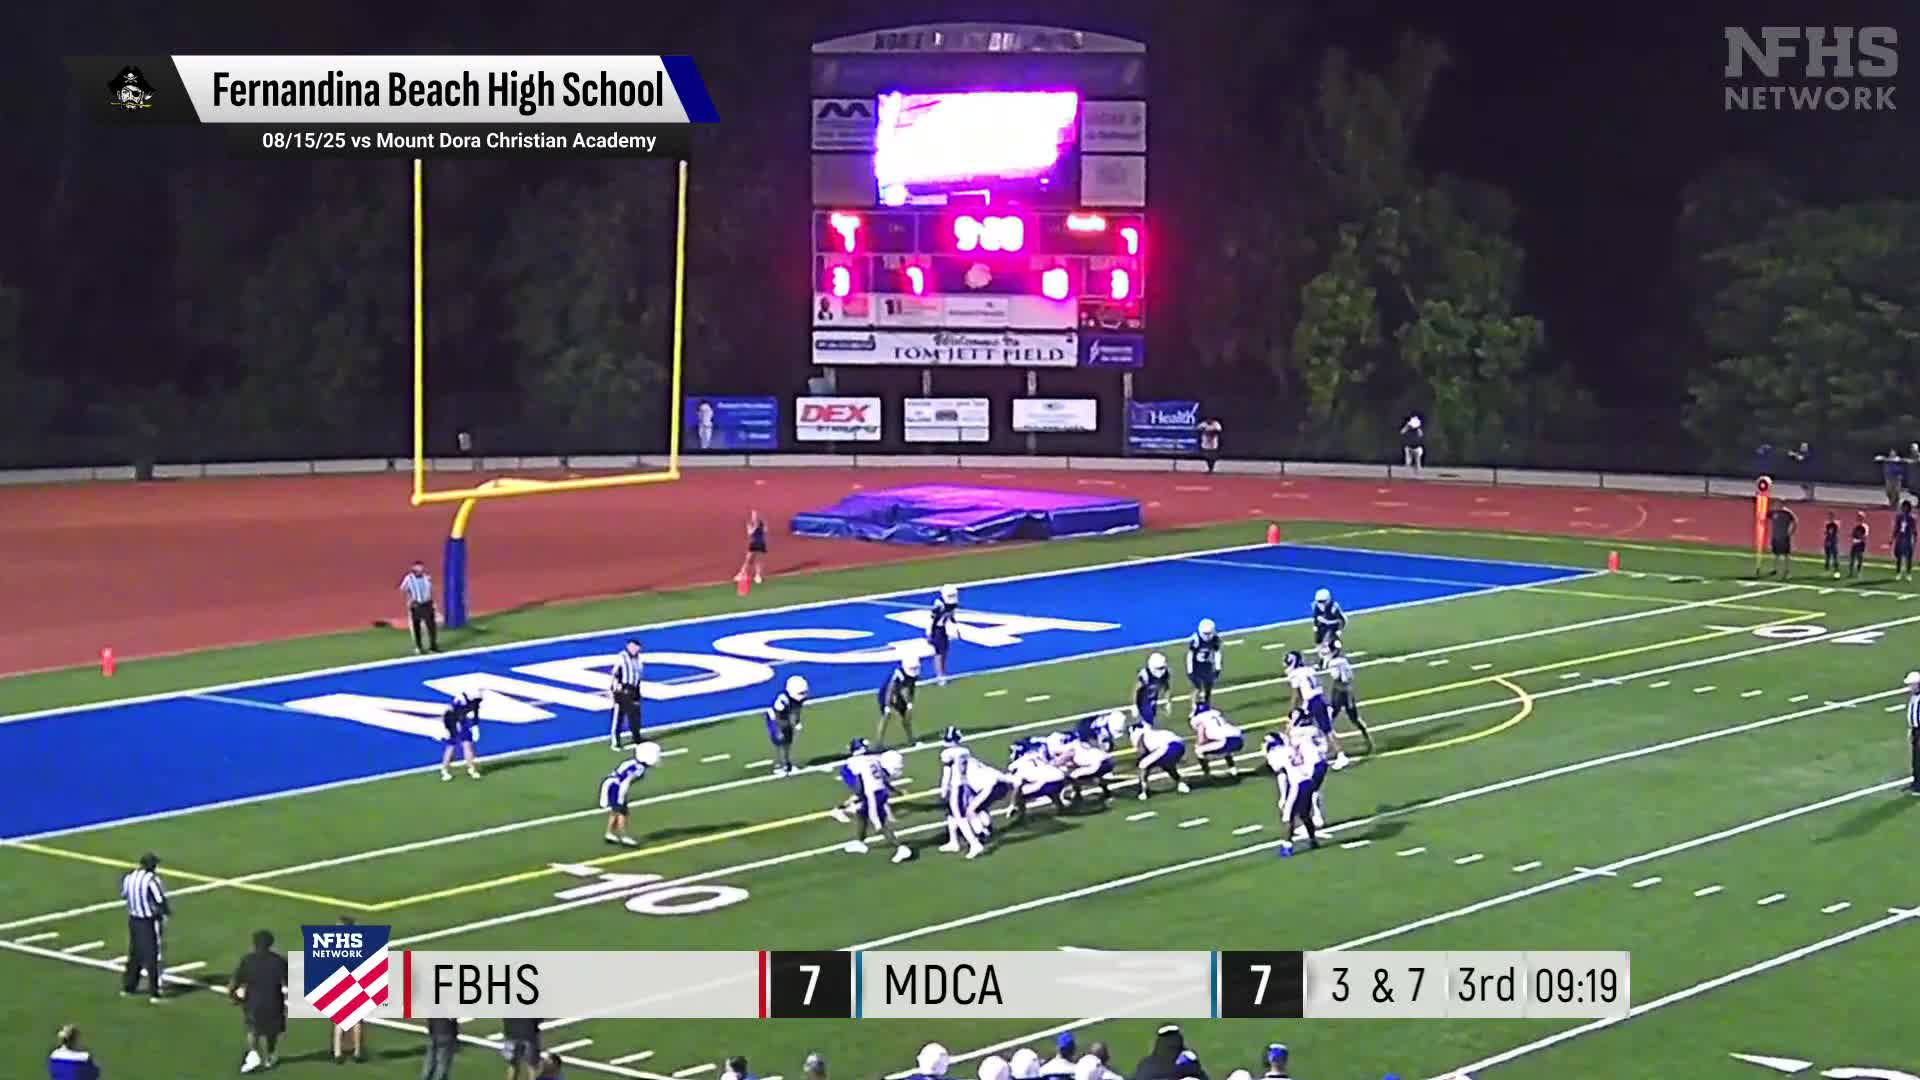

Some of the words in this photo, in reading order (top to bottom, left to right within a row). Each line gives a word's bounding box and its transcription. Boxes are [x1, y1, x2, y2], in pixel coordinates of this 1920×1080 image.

[893, 347, 940, 361] TOM
[945, 347, 992, 361] JETT
[1003, 348, 1065, 362] FIELD
[801, 404, 870, 423] DEX
[1151, 403, 1198, 425] Health
[288, 609, 1121, 735] MDCA
[553, 872, 750, 915] 10
